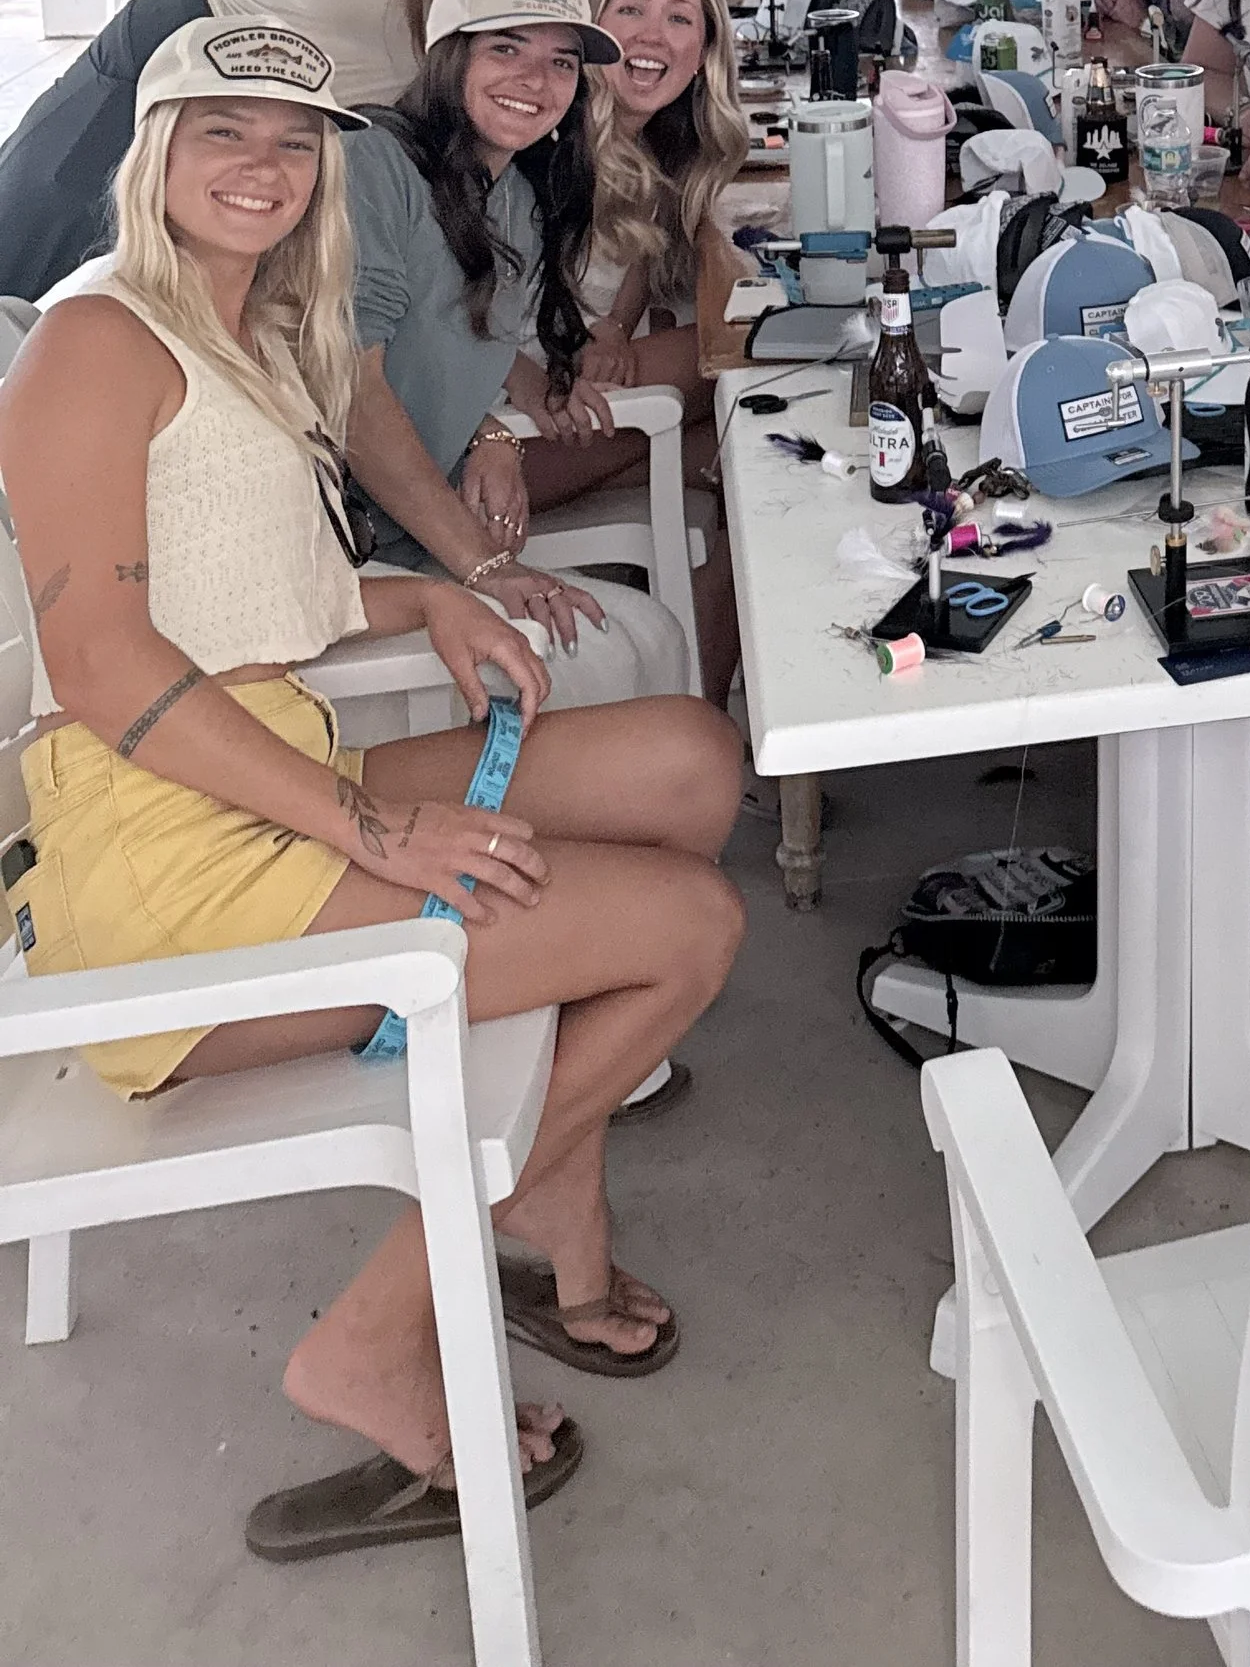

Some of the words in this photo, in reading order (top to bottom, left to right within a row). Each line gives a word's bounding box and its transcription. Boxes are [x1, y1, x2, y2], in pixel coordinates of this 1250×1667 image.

[978, 2, 1005, 22] Jai
[213, 32, 266, 52] HOWLER
[269, 32, 326, 69] BROTHERS
[230, 65, 261, 73] HEED
[265, 65, 286, 75] THE
[290, 70, 313, 86] CALL
[1087, 306, 1126, 319] CAPTAIN
[1067, 396, 1113, 415] CAPTAIN
